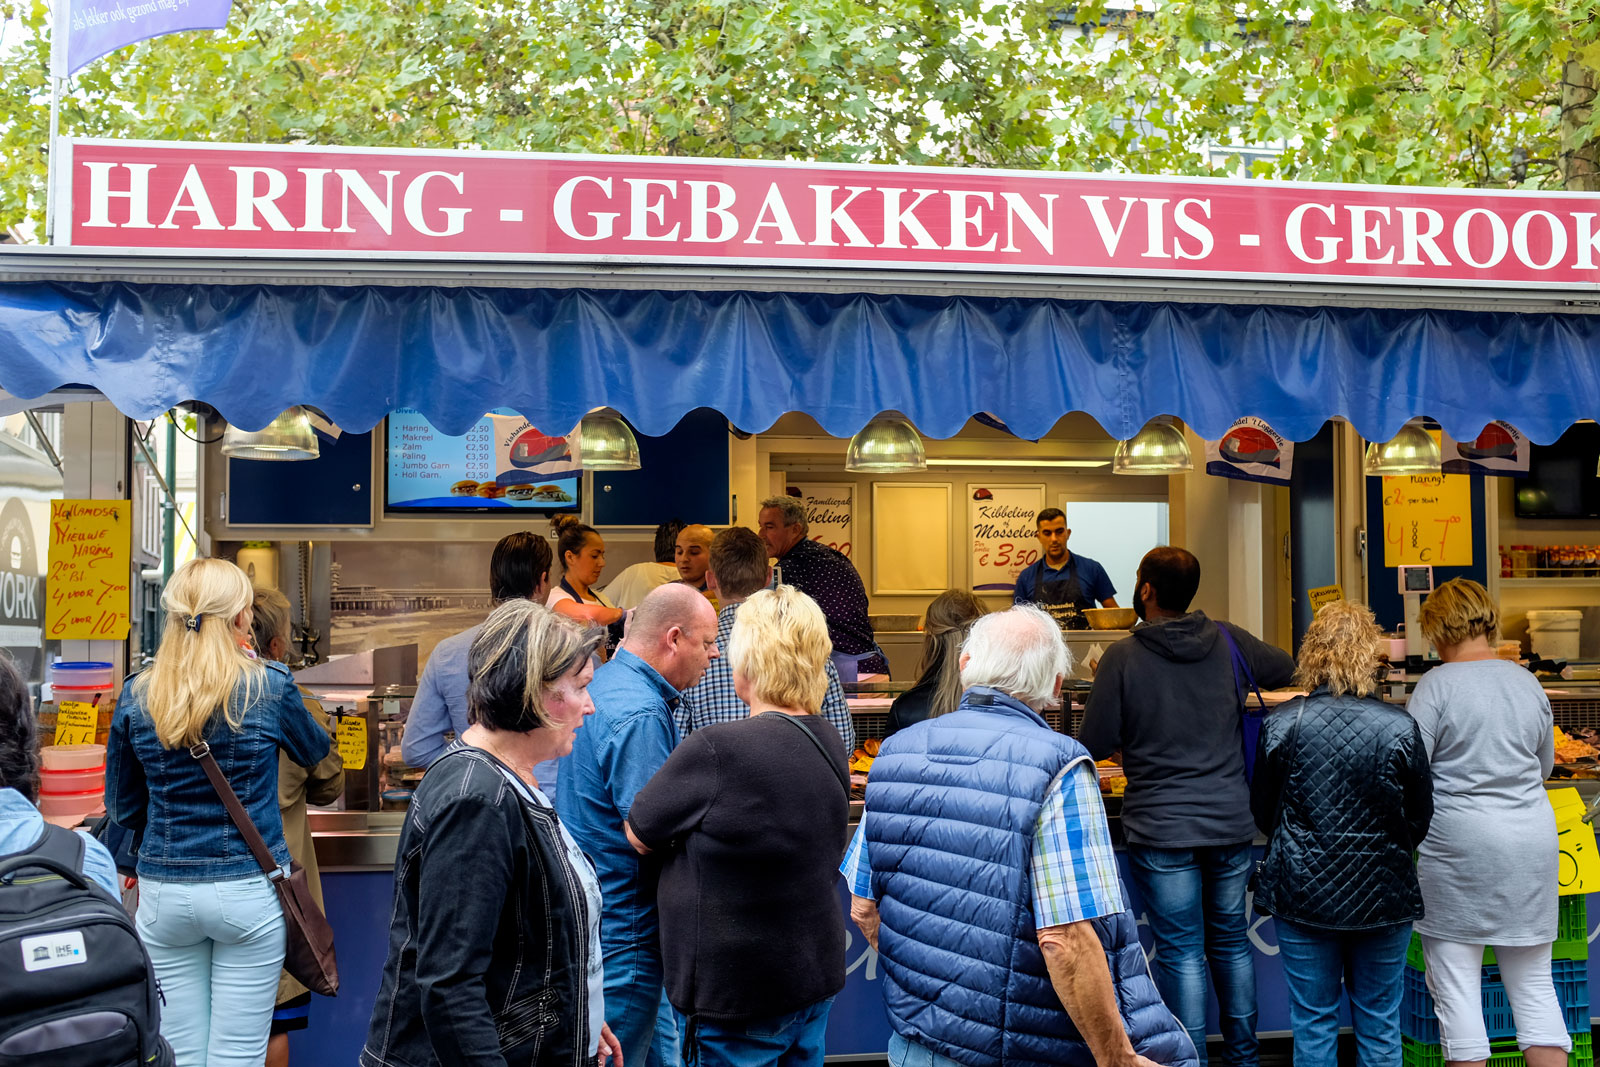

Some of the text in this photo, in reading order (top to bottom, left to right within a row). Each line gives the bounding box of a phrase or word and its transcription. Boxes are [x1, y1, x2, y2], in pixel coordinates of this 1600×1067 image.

[72, 12, 86, 31] als
[85, 6, 109, 28] lekker
[110, 3, 128, 22] ook
[126, 0, 158, 23] gezond
[82, 161, 473, 237] HARING
[553, 175, 1060, 256] GEBAKKEN
[1080, 194, 1215, 260] VIS
[395, 407, 419, 415] Diver
[402, 425, 429, 433] Haring
[503, 421, 533, 448] Vishande
[466, 434, 490, 442] €2,50
[402, 443, 490, 451] Zalm €2,50
[402, 452, 490, 461] Paling €3,50
[466, 462, 490, 470] €2,50
[402, 471, 490, 479] Holl Garn. €3,50
[807, 507, 851, 529] beling
[978, 505, 1035, 522] Kibbeling
[973, 523, 1039, 539] Mosselen
[1002, 518, 1010, 528] of
[1387, 522, 1404, 557] 4
[0, 570, 38, 620] ORK
[52, 588, 65, 606] 4
[51, 608, 72, 635] 6
[55, 943, 72, 954] IHE
